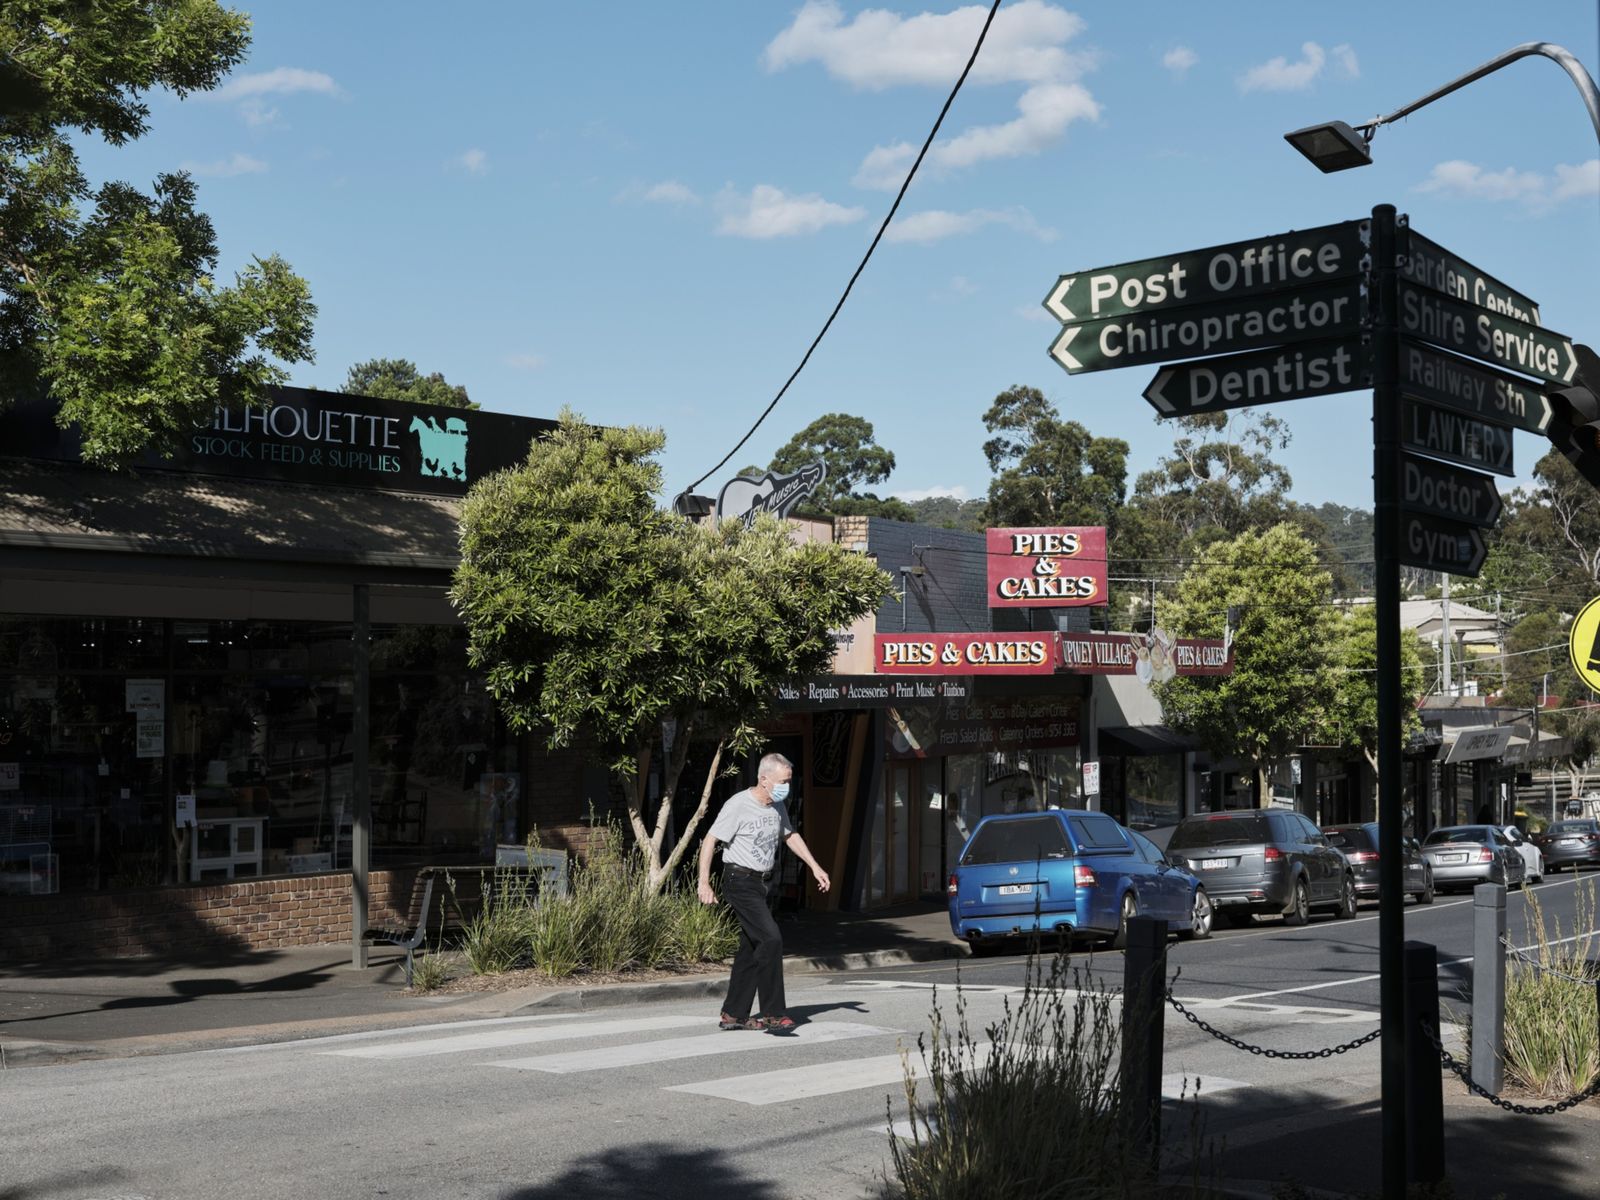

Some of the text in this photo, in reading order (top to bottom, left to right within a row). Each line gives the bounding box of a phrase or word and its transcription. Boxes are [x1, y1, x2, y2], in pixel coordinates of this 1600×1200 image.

[1090, 242, 1341, 314] Post Office
[1100, 296, 1347, 358] Chiropractor
[1403, 289, 1559, 376] Shire Service
[1189, 346, 1351, 407] Dentist
[1408, 349, 1526, 418] Railway Stn
[192, 435, 401, 473] STOCK FEED & SUPPLIES
[1413, 404, 1495, 463] LAWYER
[1404, 460, 1481, 518] Doctor
[1013, 533, 1081, 555] PIES
[1408, 519, 1458, 565] Gym
[1036, 555, 1057, 576] &
[999, 576, 1096, 599] CAKES
[883, 641, 1045, 665] PIES & CAKES
[1095, 641, 1133, 665] VILLAGE
[1177, 645, 1194, 666] PIES
[1202, 645, 1225, 666] CAKES
[808, 682, 840, 703] Repairs
[847, 683, 889, 699] Accessories
[896, 682, 914, 698] Print
[915, 681, 936, 697] Music
[942, 682, 966, 697] Tuition
